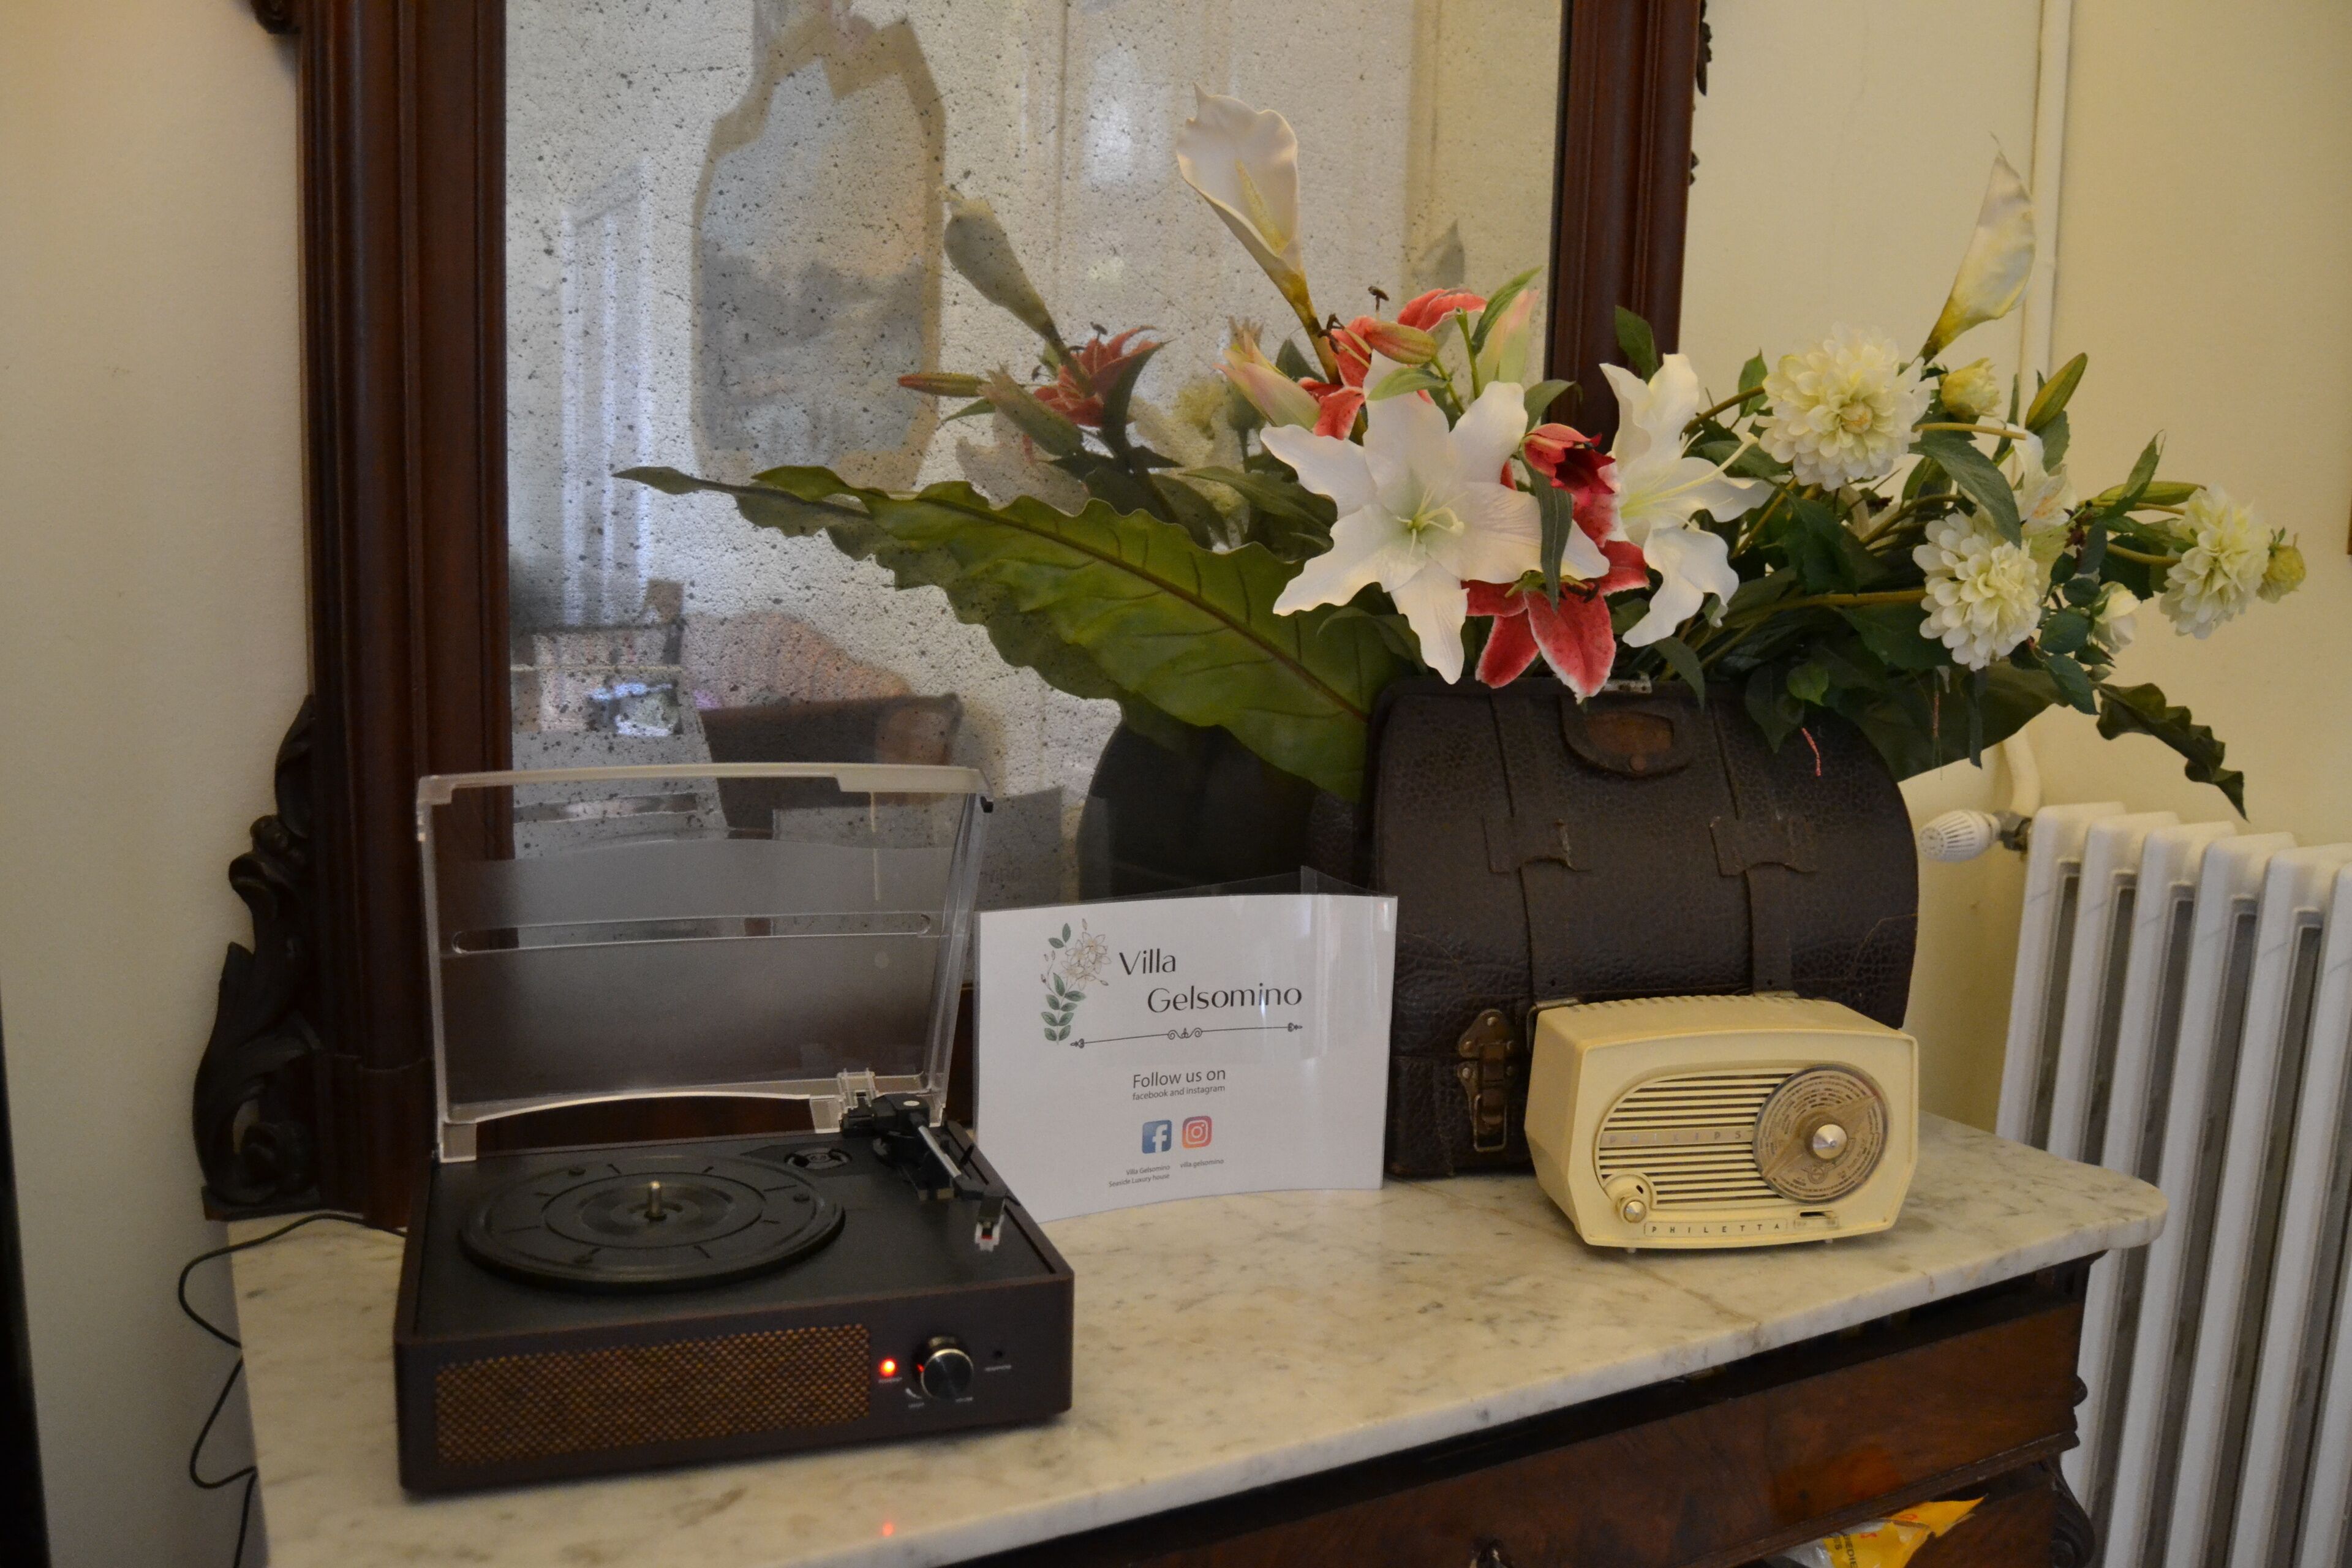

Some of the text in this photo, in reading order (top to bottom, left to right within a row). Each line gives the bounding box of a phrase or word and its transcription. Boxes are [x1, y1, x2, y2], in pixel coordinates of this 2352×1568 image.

[1119, 948, 1176, 975] Villa
[1147, 982, 1302, 1013] Gelsomino
[1133, 1069, 1226, 1088] Follow us on
[1133, 1085, 1226, 1101] facebook and instagram
[1126, 1164, 1171, 1175] Villa Gelsomino
[1651, 1223, 1780, 1234] PHILETTA
